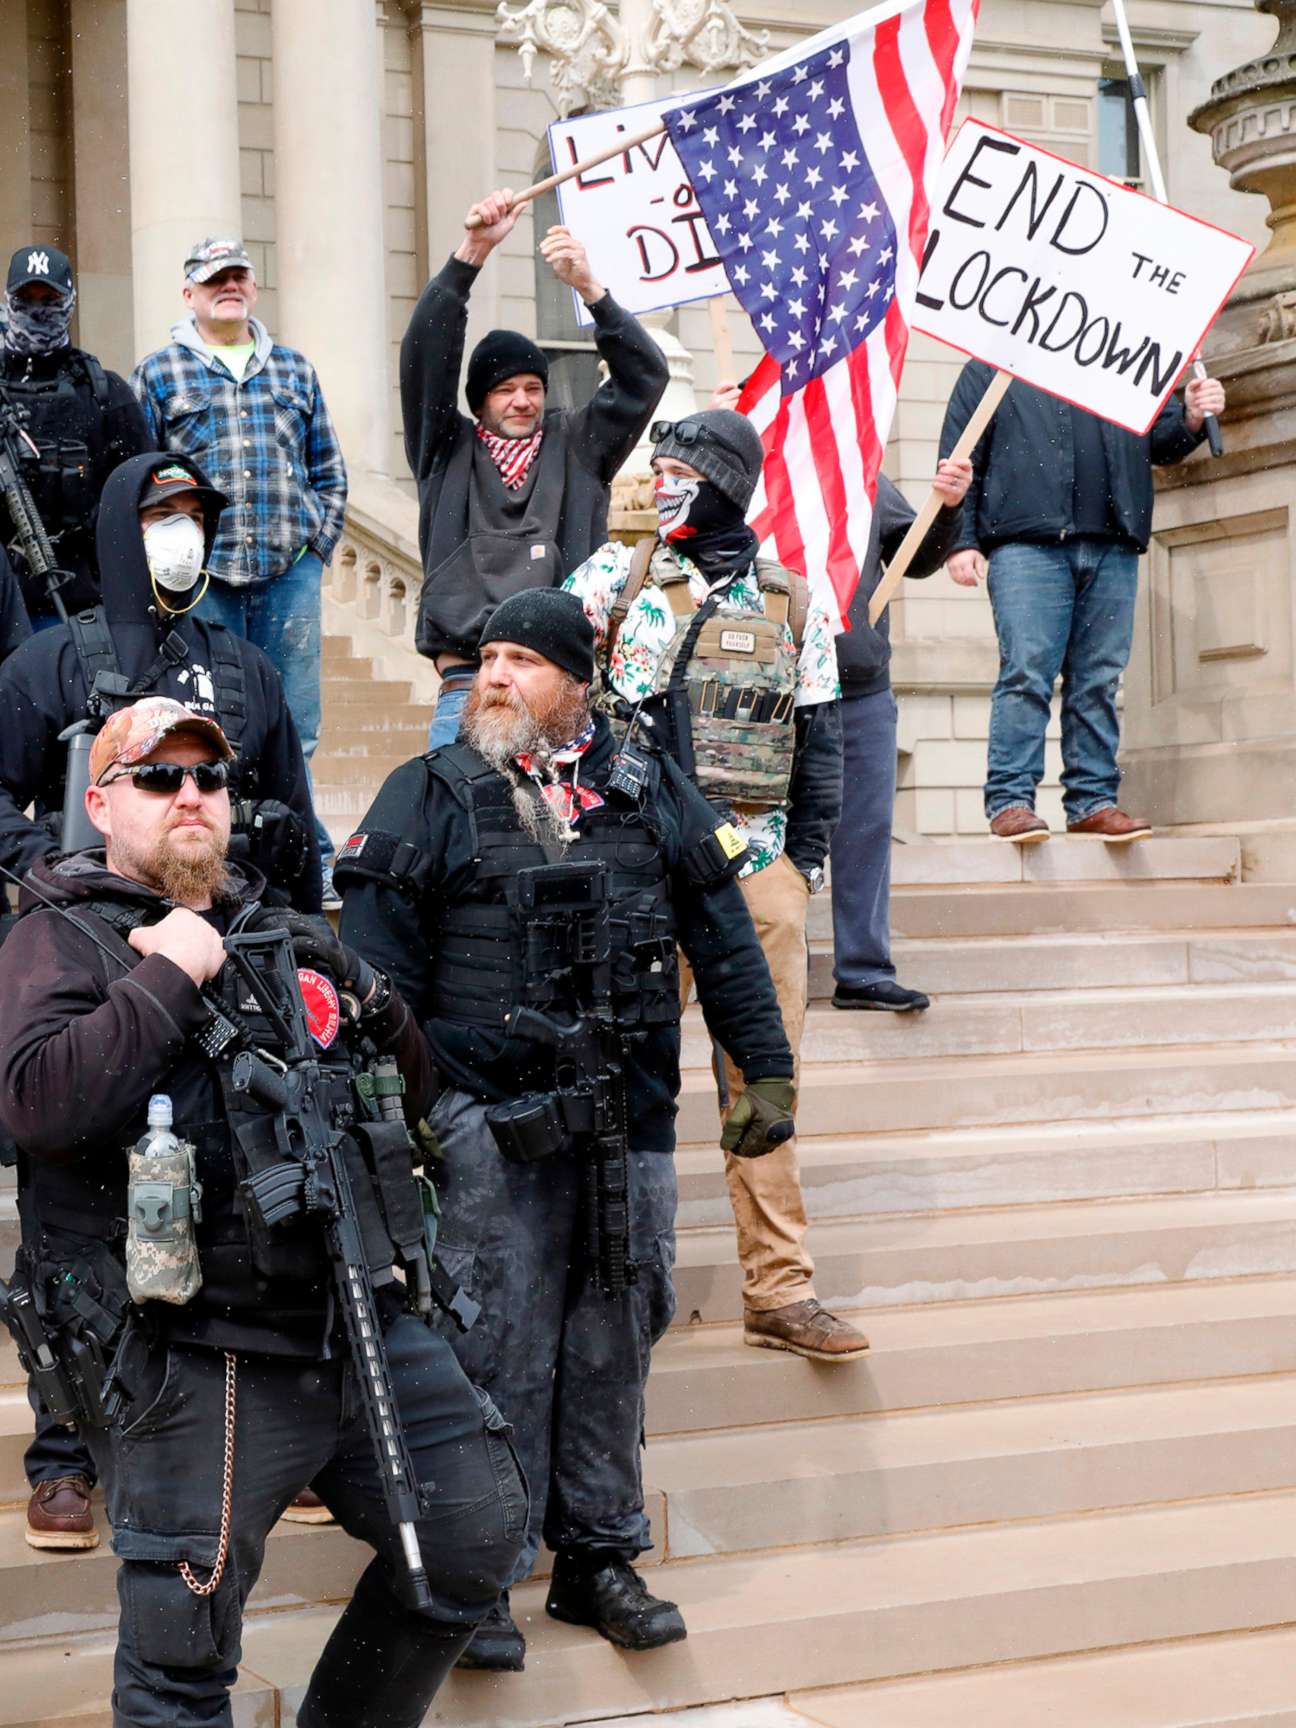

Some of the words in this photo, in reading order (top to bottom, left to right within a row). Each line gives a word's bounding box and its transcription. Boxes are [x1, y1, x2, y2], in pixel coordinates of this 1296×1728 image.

[27, 251, 50, 275] NY
[626, 210, 724, 283] DI
[942, 134, 1109, 255] END
[1132, 251, 1187, 295] THE
[915, 228, 1183, 398] LOCKDOWN
